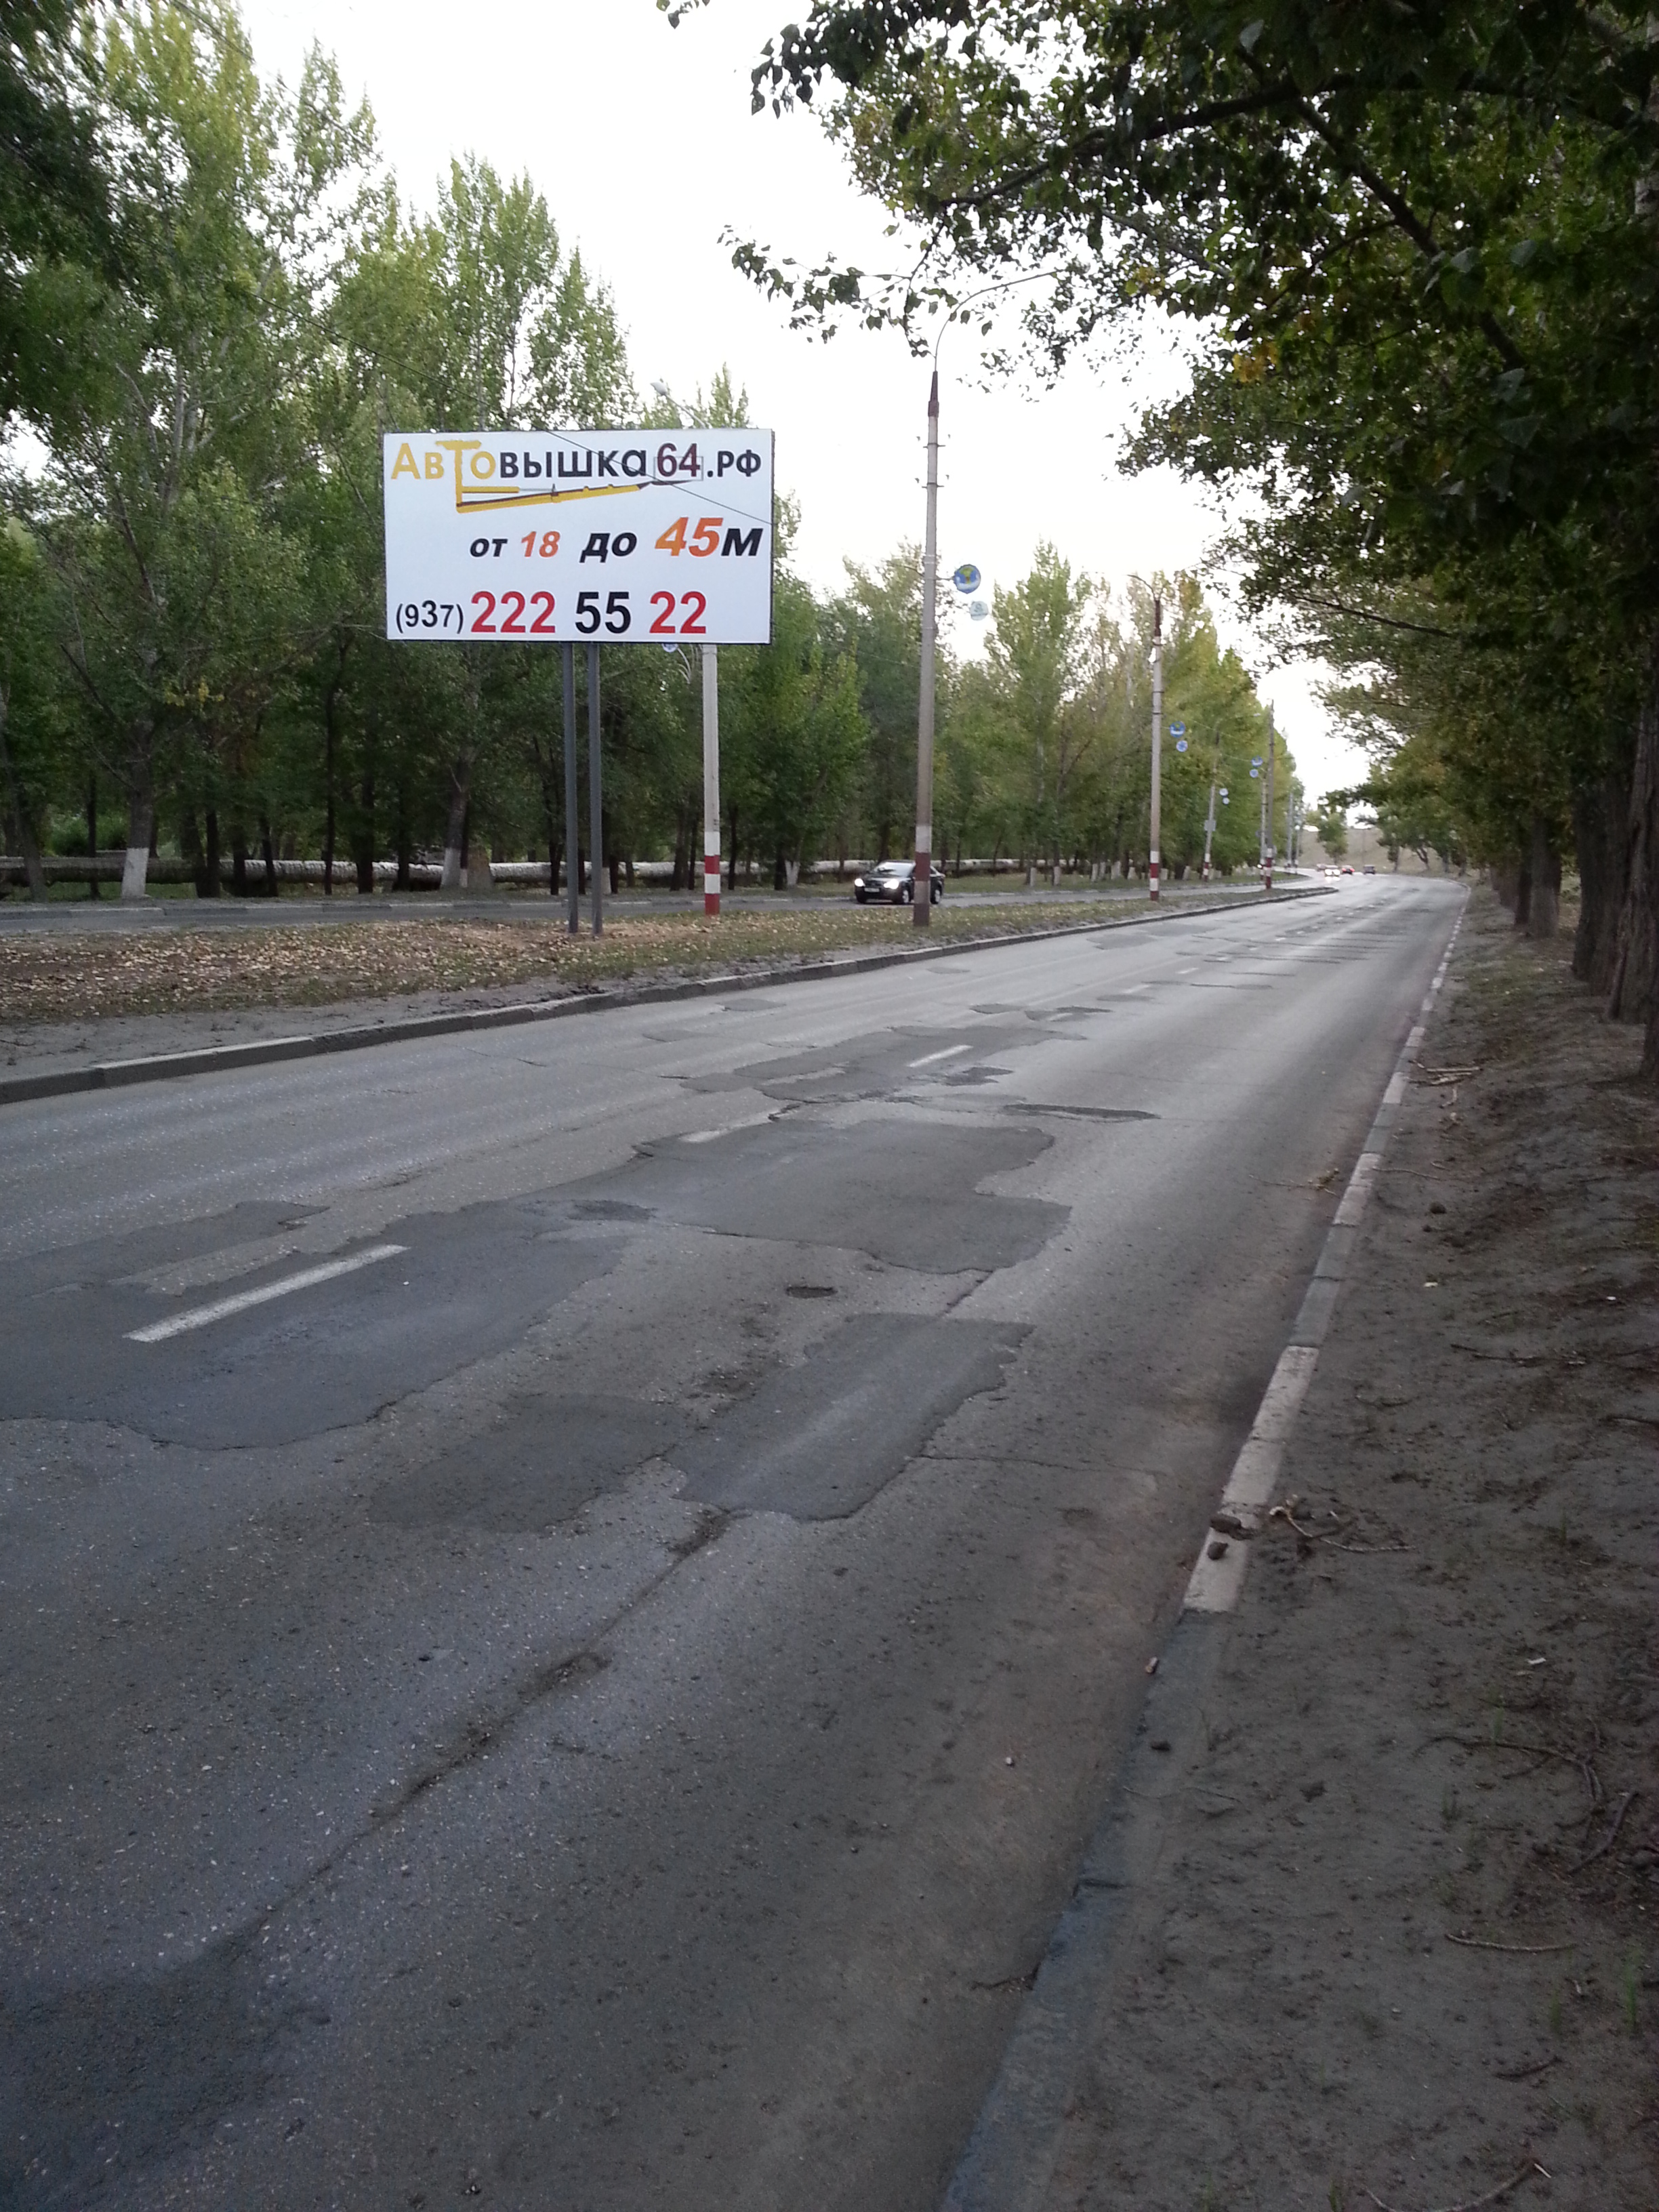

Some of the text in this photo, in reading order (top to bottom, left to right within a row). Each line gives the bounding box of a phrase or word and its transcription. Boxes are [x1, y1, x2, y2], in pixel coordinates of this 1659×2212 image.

[470, 537, 508, 557] от
[520, 531, 560, 557] 18
[579, 533, 637, 563] до
[396, 591, 706, 634] (937) 222 55 22
